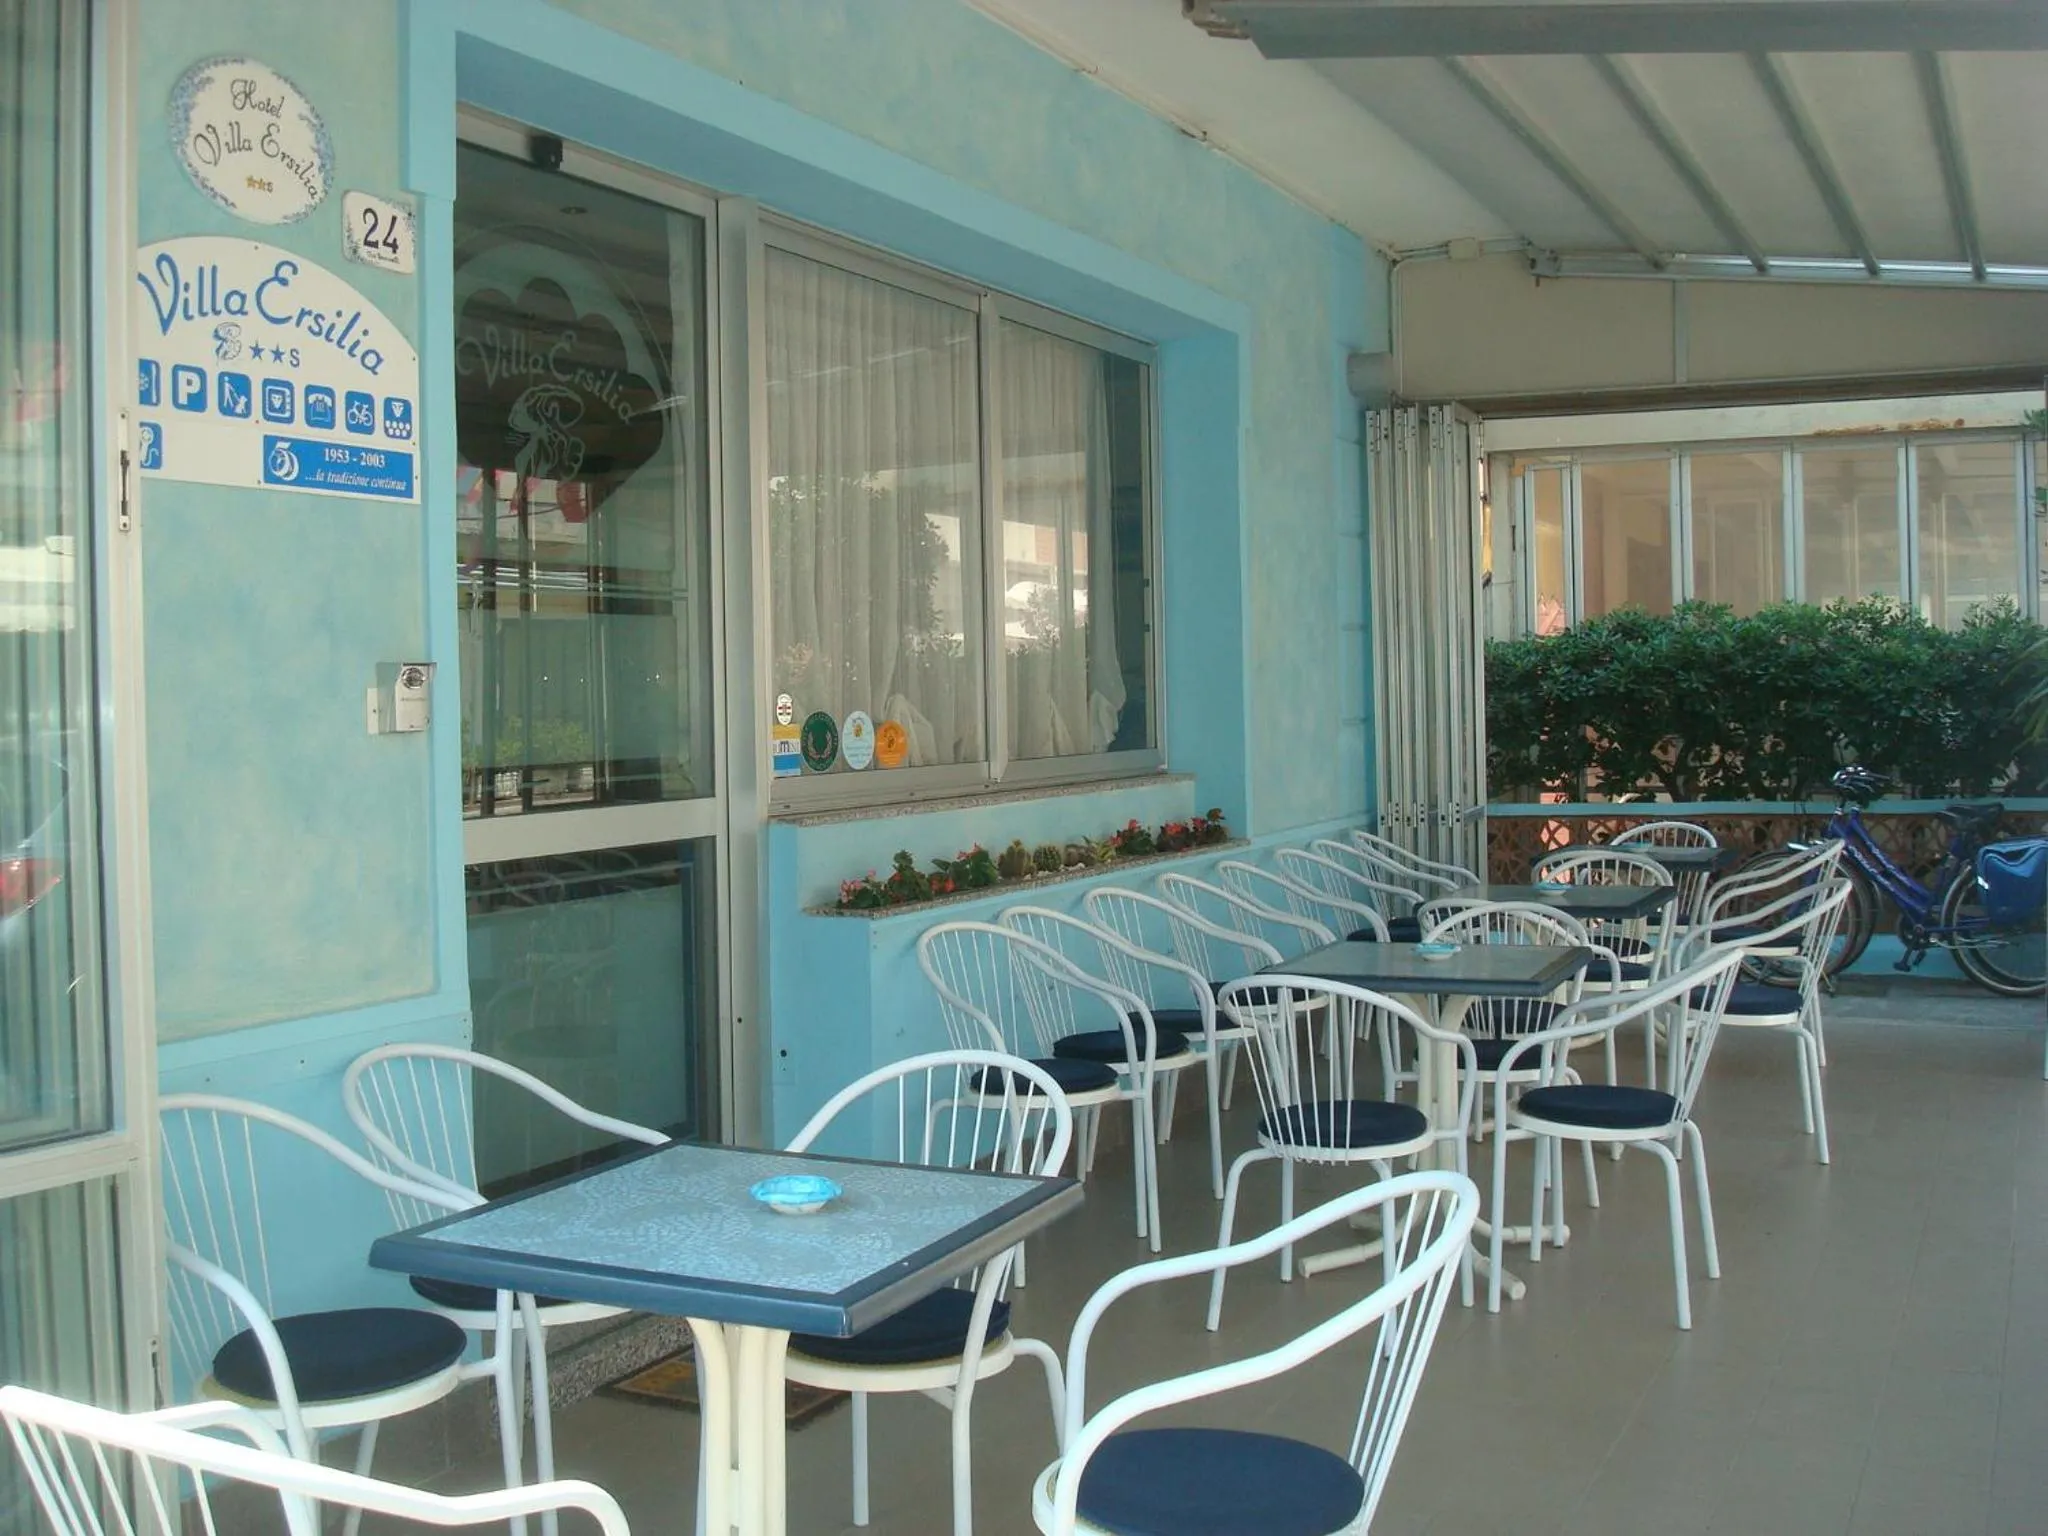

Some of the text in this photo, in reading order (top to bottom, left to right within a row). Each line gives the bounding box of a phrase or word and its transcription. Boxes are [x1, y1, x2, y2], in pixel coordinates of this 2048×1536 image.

[230, 79, 284, 119] Hotel
[193, 121, 319, 200] Villa Ersilia
[362, 207, 399, 254] 24
[137, 253, 384, 375] Villa Ersilia
[177, 370, 202, 405] P
[456, 325, 634, 424] Villa Ersilia
[324, 447, 350, 463] 1953
[360, 452, 386, 468] 2003
